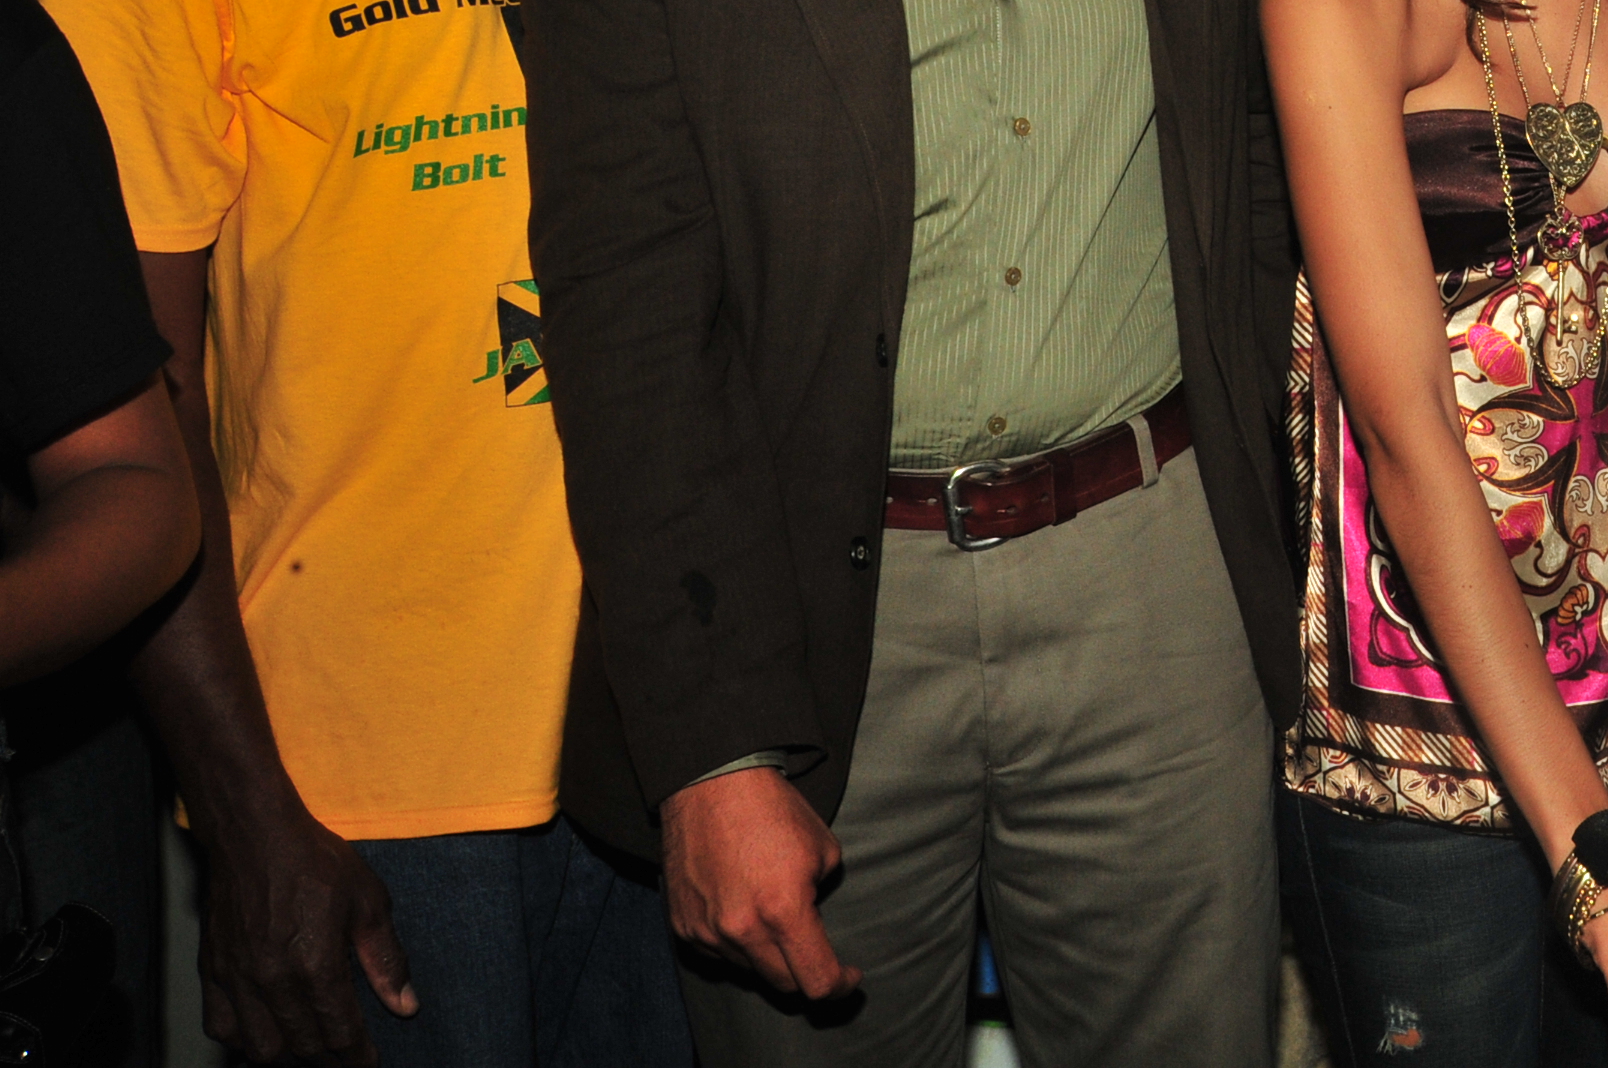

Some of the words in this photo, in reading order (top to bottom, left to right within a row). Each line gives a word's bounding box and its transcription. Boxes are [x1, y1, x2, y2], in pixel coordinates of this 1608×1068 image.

[352, 103, 528, 159] Lightnin
[410, 152, 507, 192] Bolt
[472, 338, 543, 384] JA
